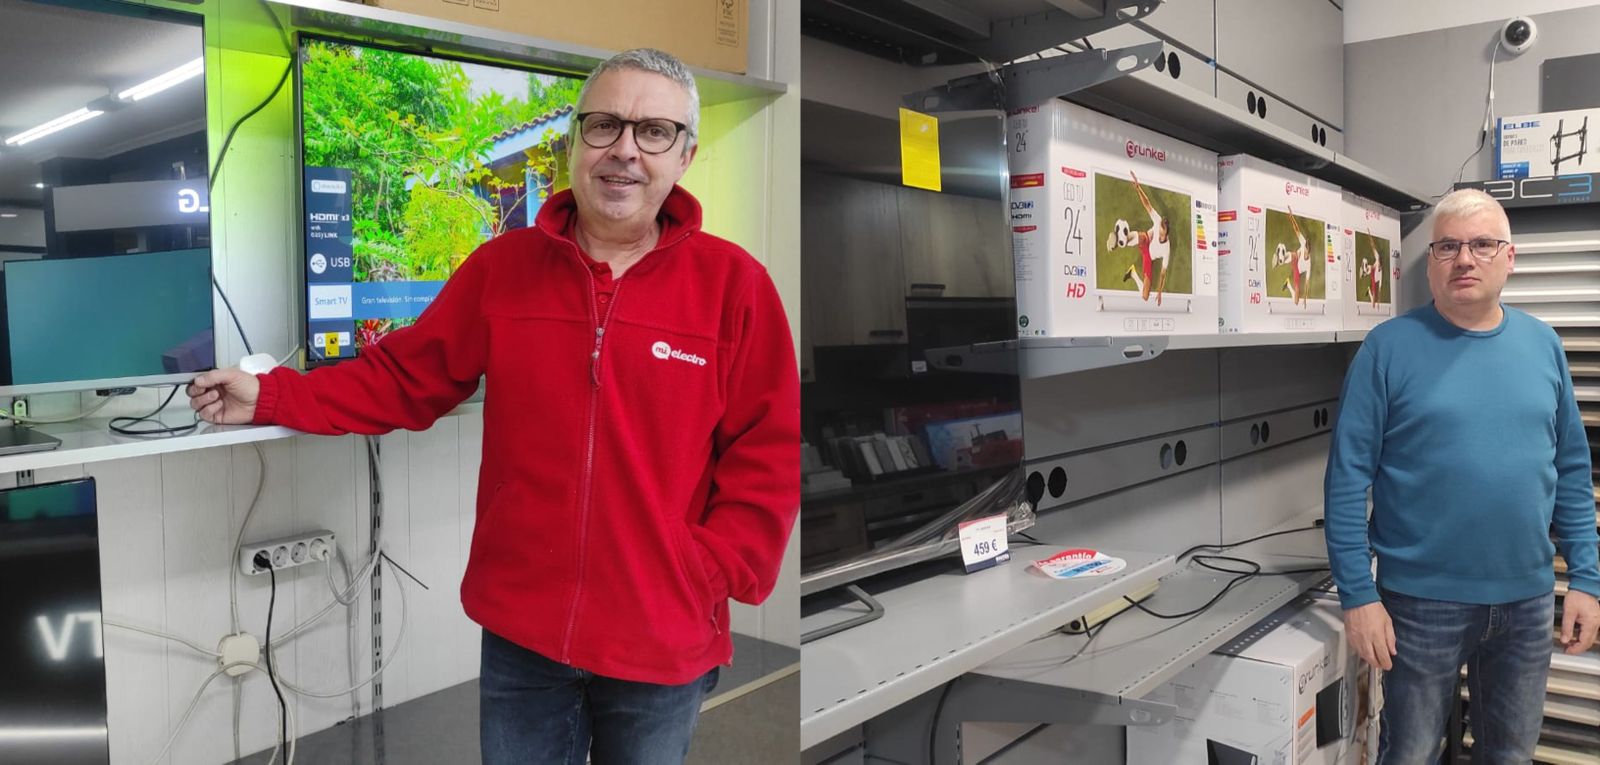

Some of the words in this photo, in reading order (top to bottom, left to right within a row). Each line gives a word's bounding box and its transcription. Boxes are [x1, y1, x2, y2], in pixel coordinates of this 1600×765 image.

[1503, 120, 1541, 130] ELBE
[310, 212, 338, 224] HDMI
[330, 256, 351, 268] USB
[1066, 282, 1087, 298] HD
[314, 297, 336, 306] Smart
[338, 297, 348, 305] TV
[1250, 292, 1262, 304] HD
[671, 349, 707, 366] electro
[973, 541, 991, 557] 459
[991, 538, 998, 552] €
